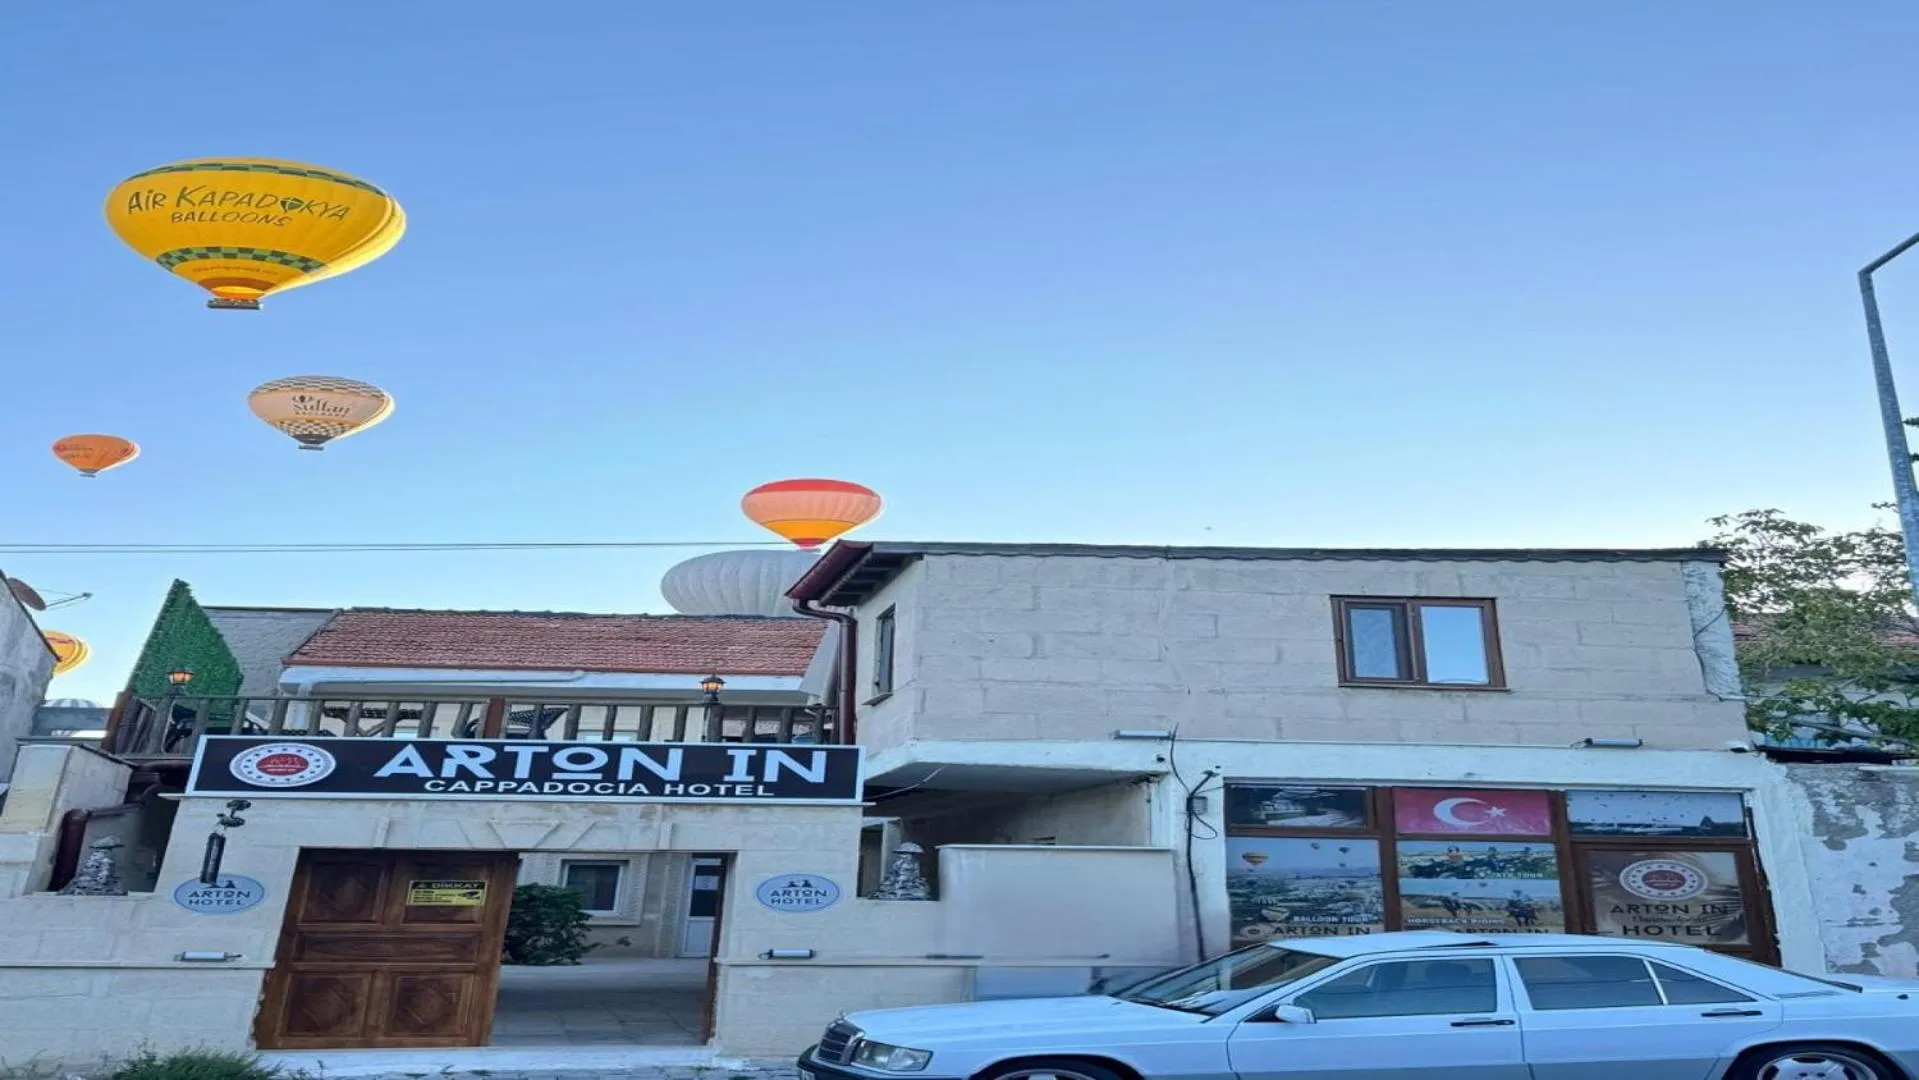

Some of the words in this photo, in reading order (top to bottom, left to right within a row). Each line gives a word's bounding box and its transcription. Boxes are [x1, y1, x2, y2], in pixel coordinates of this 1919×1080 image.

[171, 210, 293, 227] BALLOONS
[373, 743, 683, 781] ARTON
[724, 748, 827, 783] IN
[424, 780, 650, 795] CAPPADOCIA
[664, 783, 774, 797] HOTEL
[188, 890, 251, 898] ARTON
[770, 889, 827, 898] ARTON
[1610, 903, 1689, 915] ARTON
[1700, 903, 1728, 914] IN
[1273, 926, 1338, 936] ARTON
[1348, 926, 1370, 936] IN
[1622, 924, 1721, 936] HOTEL
